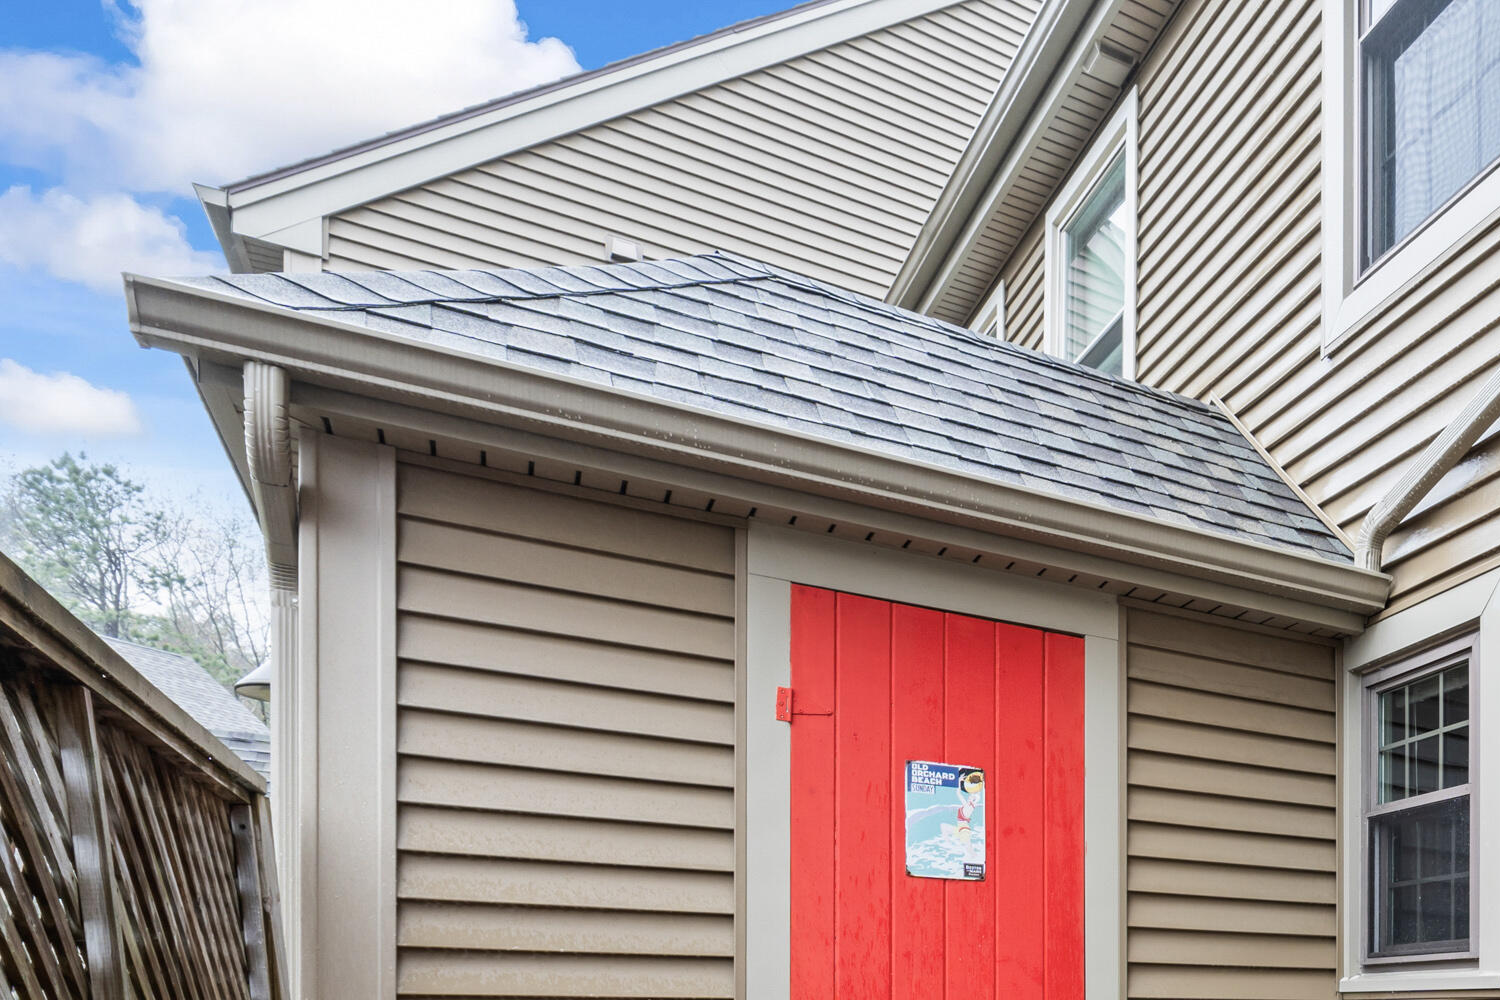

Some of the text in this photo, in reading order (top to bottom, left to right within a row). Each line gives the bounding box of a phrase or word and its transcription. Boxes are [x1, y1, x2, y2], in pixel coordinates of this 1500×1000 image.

[911, 763, 929, 771] OLD
[911, 769, 956, 781] ORCHARD
[911, 776, 943, 786] BEACH
[912, 784, 934, 793] SUNDAY
